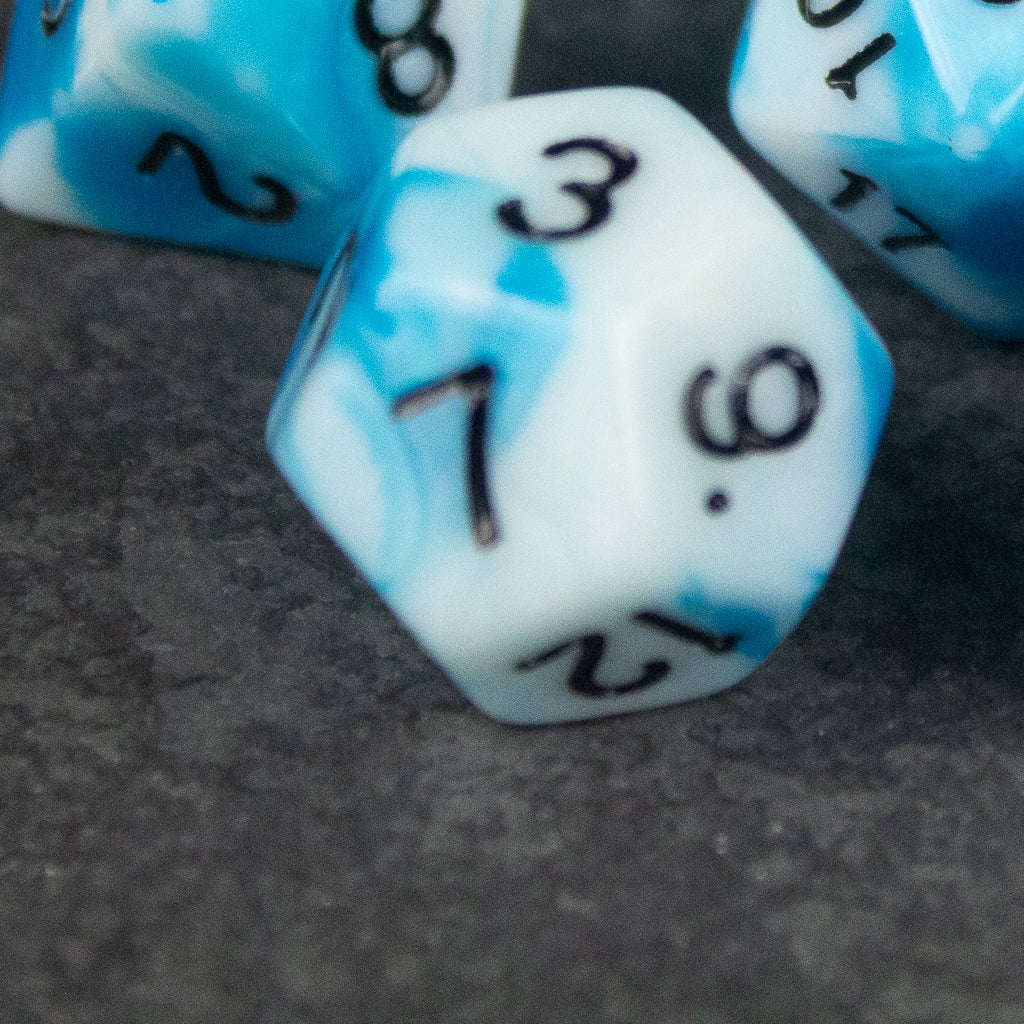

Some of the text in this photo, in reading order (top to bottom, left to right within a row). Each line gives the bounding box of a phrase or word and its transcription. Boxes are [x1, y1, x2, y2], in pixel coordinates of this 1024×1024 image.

[136, 131, 298, 224] 2
[498, 138, 640, 242] 3
[391, 365, 499, 549] 7
[513, 609, 742, 698] 12
